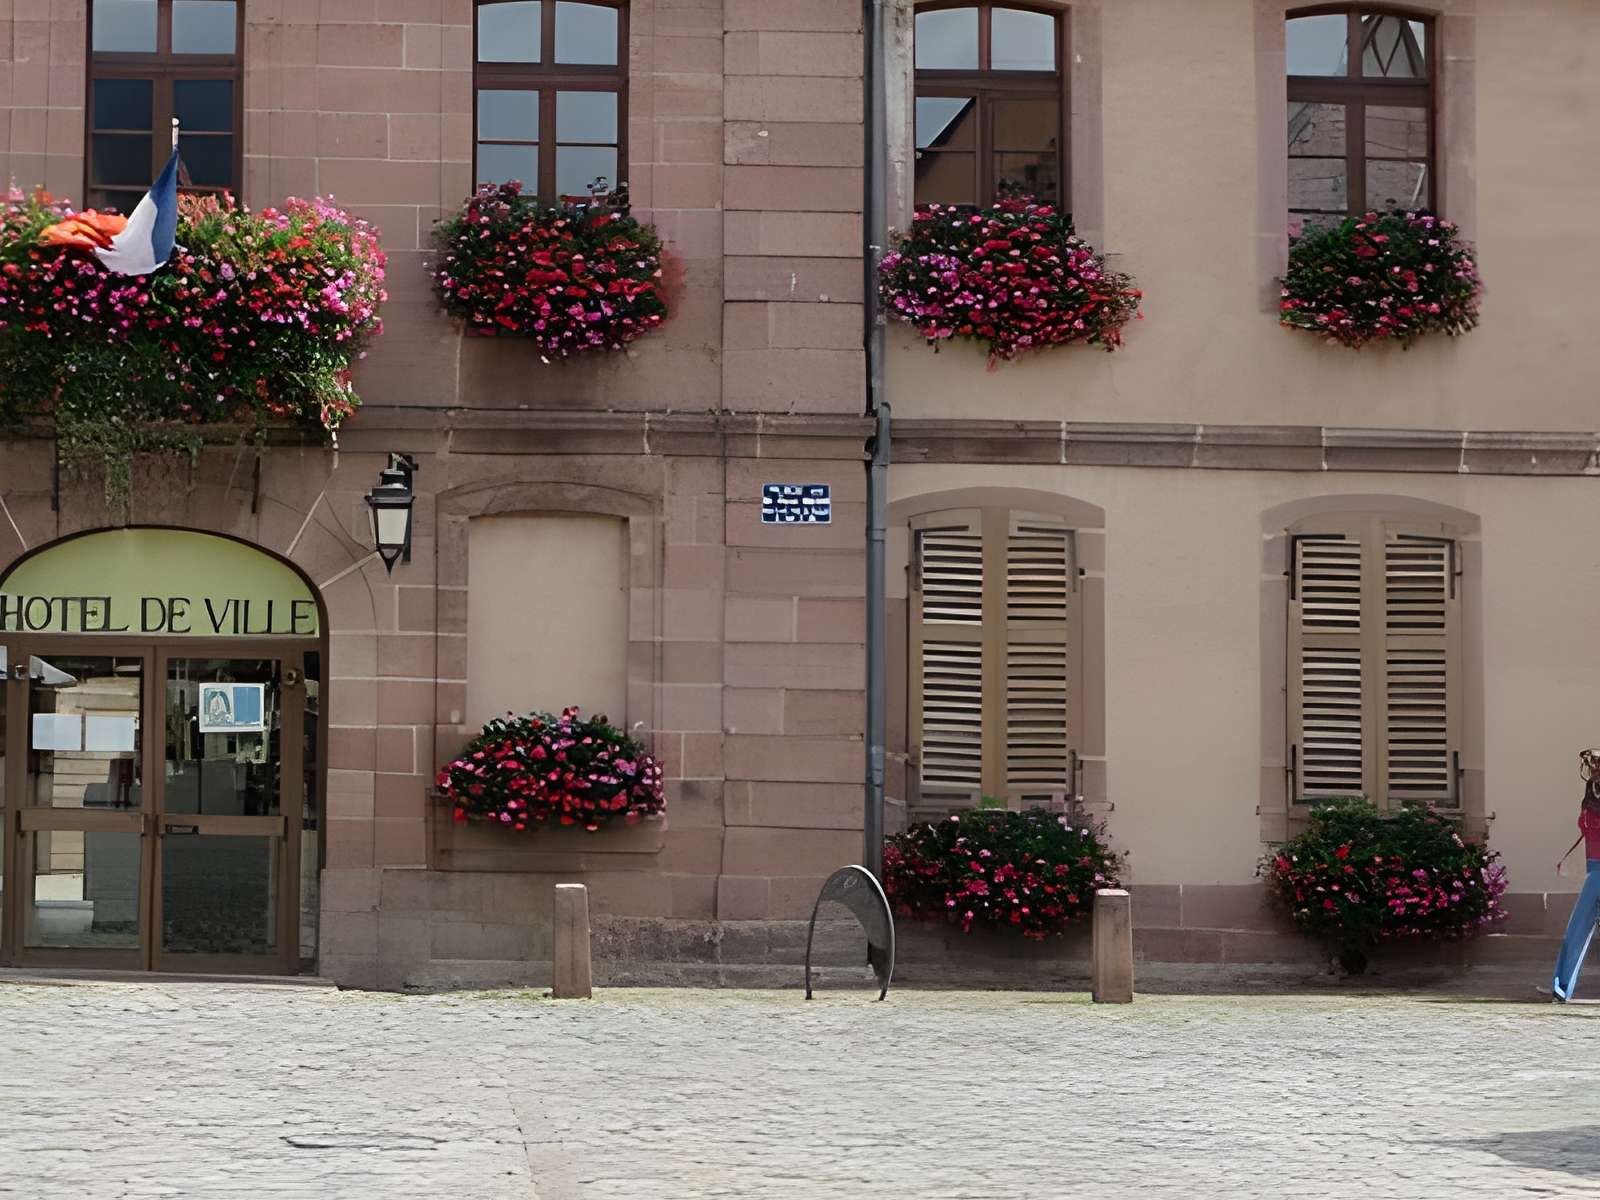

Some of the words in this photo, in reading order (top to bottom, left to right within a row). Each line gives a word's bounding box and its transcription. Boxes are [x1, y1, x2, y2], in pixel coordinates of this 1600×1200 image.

[0, 595, 130, 632] HOTEL
[141, 597, 191, 633] DE
[204, 598, 315, 635] VILLE
